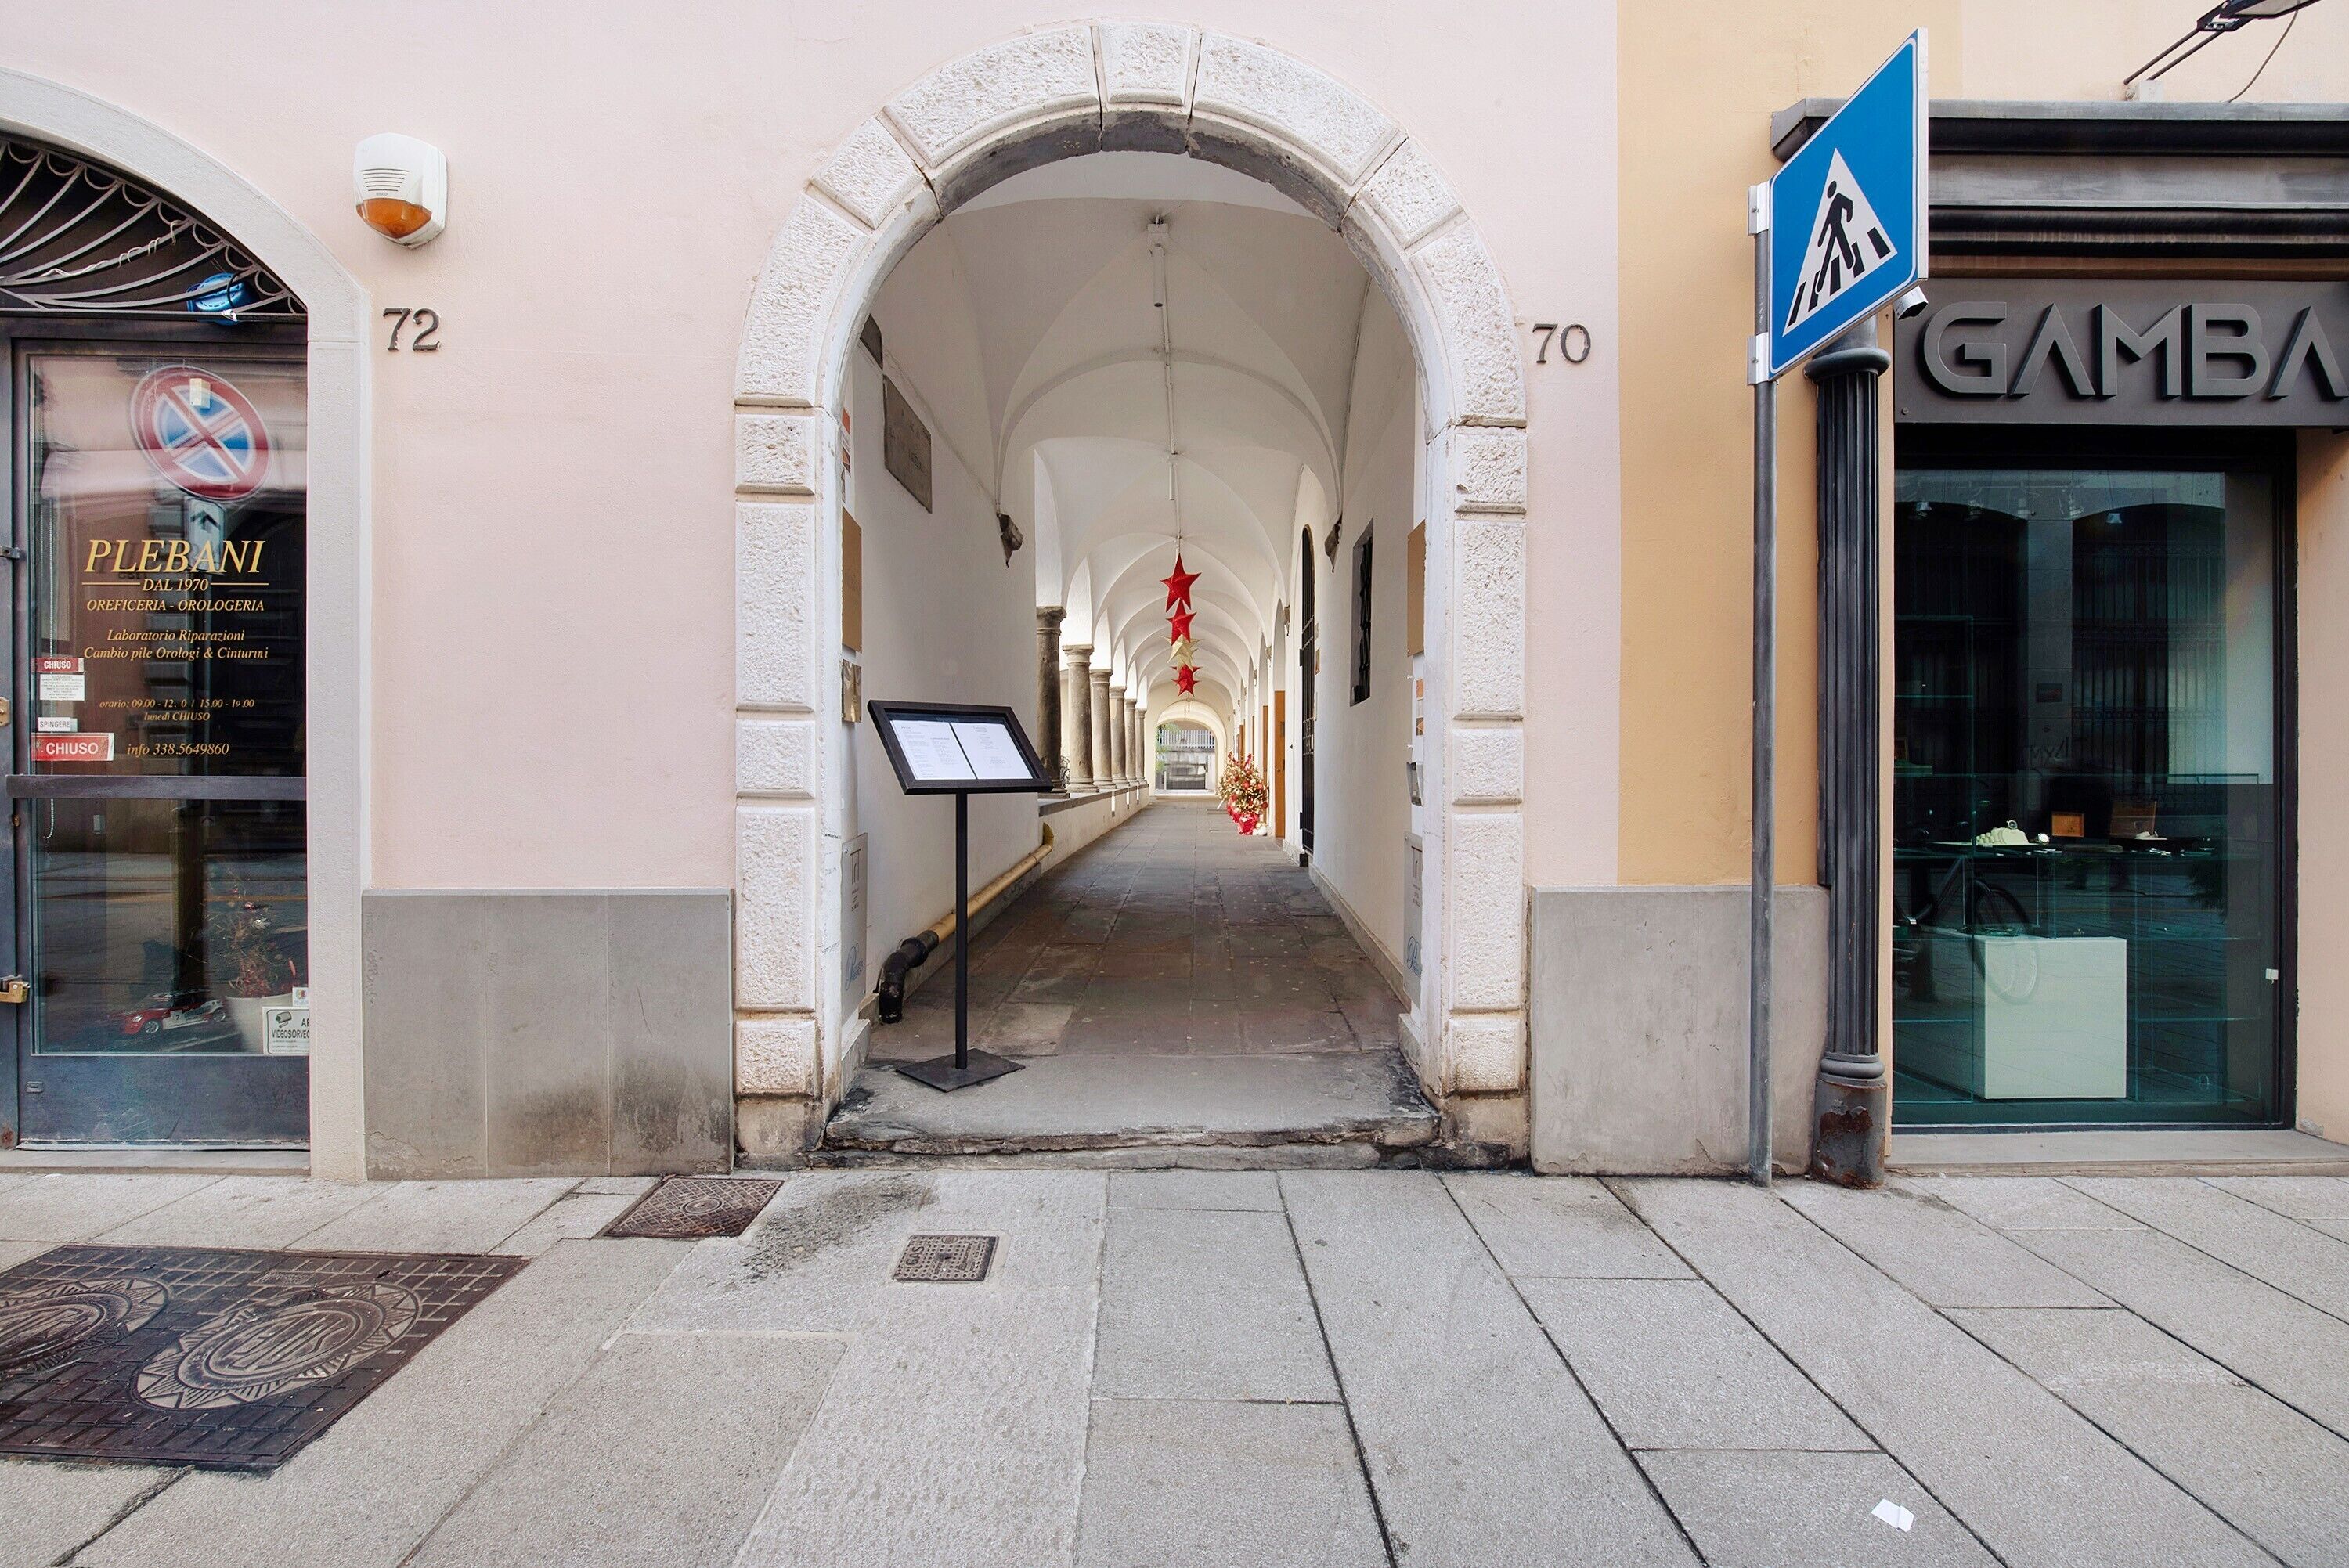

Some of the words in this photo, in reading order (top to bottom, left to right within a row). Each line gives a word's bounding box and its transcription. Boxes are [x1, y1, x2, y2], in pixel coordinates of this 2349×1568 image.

[383, 308, 440, 351] 72
[1532, 323, 1591, 363] 70
[1921, 301, 2349, 401] GAMBA
[83, 539, 266, 574] PLEBANI
[142, 579, 173, 592] DAL
[176, 578, 209, 592] 1970
[86, 599, 167, 611] OREFICERIA
[178, 599, 265, 611] OROLOGERIA
[107, 629, 175, 641] Laboratorio
[179, 629, 245, 643] Riparazioni
[84, 647, 128, 659] Cambio
[130, 647, 153, 661] pile
[156, 647, 200, 661] Orologi
[203, 647, 214, 659] &
[43, 661, 72, 669] CHIUSO
[99, 699, 130, 708] orario:
[131, 698, 156, 708] 09.00
[200, 698, 223, 708] 15.00
[172, 712, 211, 721] CHIUSO
[45, 742, 99, 755] CHIUSO
[127, 744, 150, 758] info
[153, 743, 229, 755] 338.5649860
[906, 1246, 925, 1266] GAS
